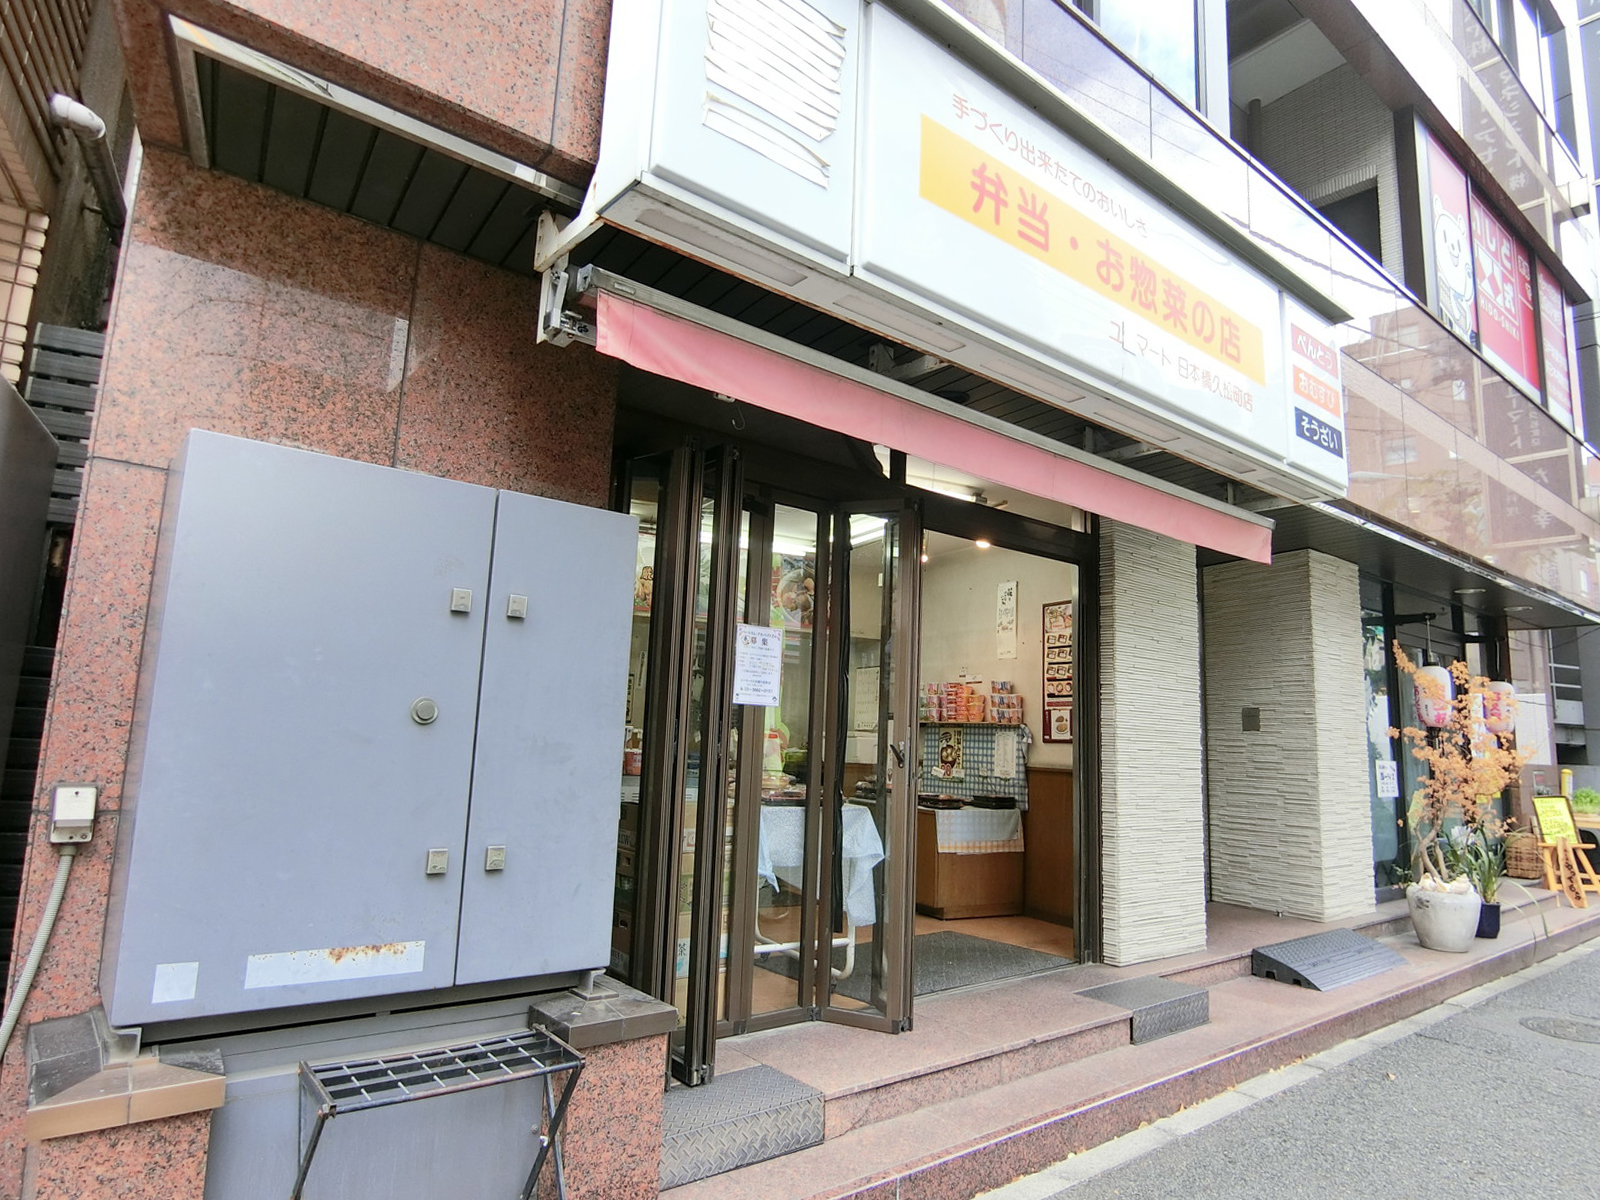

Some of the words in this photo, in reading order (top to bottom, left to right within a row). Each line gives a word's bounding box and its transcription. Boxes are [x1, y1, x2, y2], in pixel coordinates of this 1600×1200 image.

[953, 94, 1148, 238] 手づくり出来たてのおいしさ
[970, 162, 1241, 364] 弁当・お惣菜の店
[1178, 356, 1253, 413] 日本橋久松町店
[1301, 415, 1339, 450] そうざい
